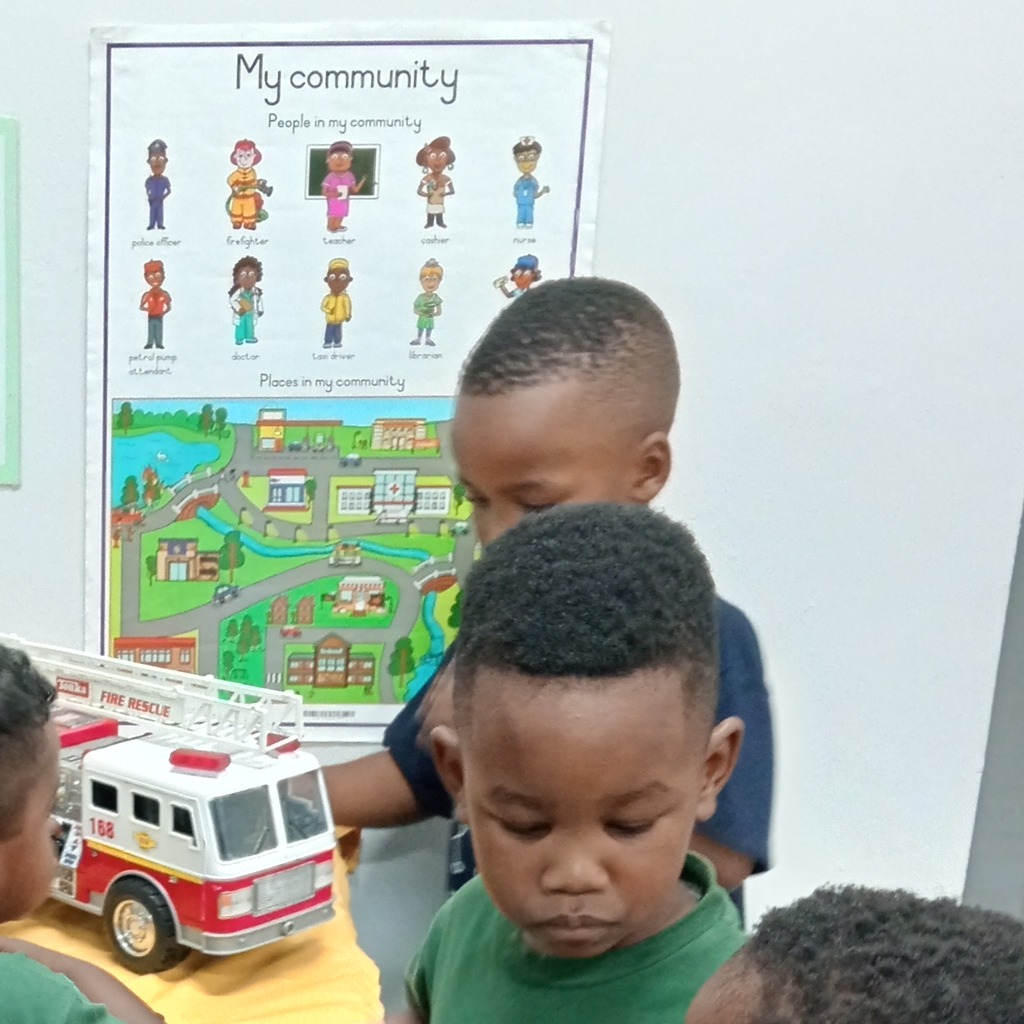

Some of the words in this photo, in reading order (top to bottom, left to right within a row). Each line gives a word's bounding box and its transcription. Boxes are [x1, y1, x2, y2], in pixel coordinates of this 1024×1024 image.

[235, 53, 282, 106] My
[289, 59, 459, 105] community
[268, 112, 311, 134] People
[314, 115, 326, 128] in
[328, 117, 347, 134] my
[350, 115, 423, 134] community
[131, 237, 155, 250] police
[156, 236, 182, 247] officer
[226, 235, 270, 249] firefighter
[323, 236, 357, 245] teacher
[420, 235, 451, 245] cashier
[512, 236, 537, 244] nurse
[128, 352, 155, 366] petrol
[156, 354, 178, 366] pump
[231, 352, 261, 361] doctor
[312, 352, 329, 361] taxi
[330, 352, 356, 361] driver
[408, 351, 443, 360] librarian
[128, 366, 173, 376] attendant
[259, 372, 299, 388] Places
[301, 375, 312, 388] in
[315, 377, 334, 393] my
[336, 375, 406, 393] community
[100, 690, 126, 707] FIRE
[127, 696, 171, 718] RESCUE
